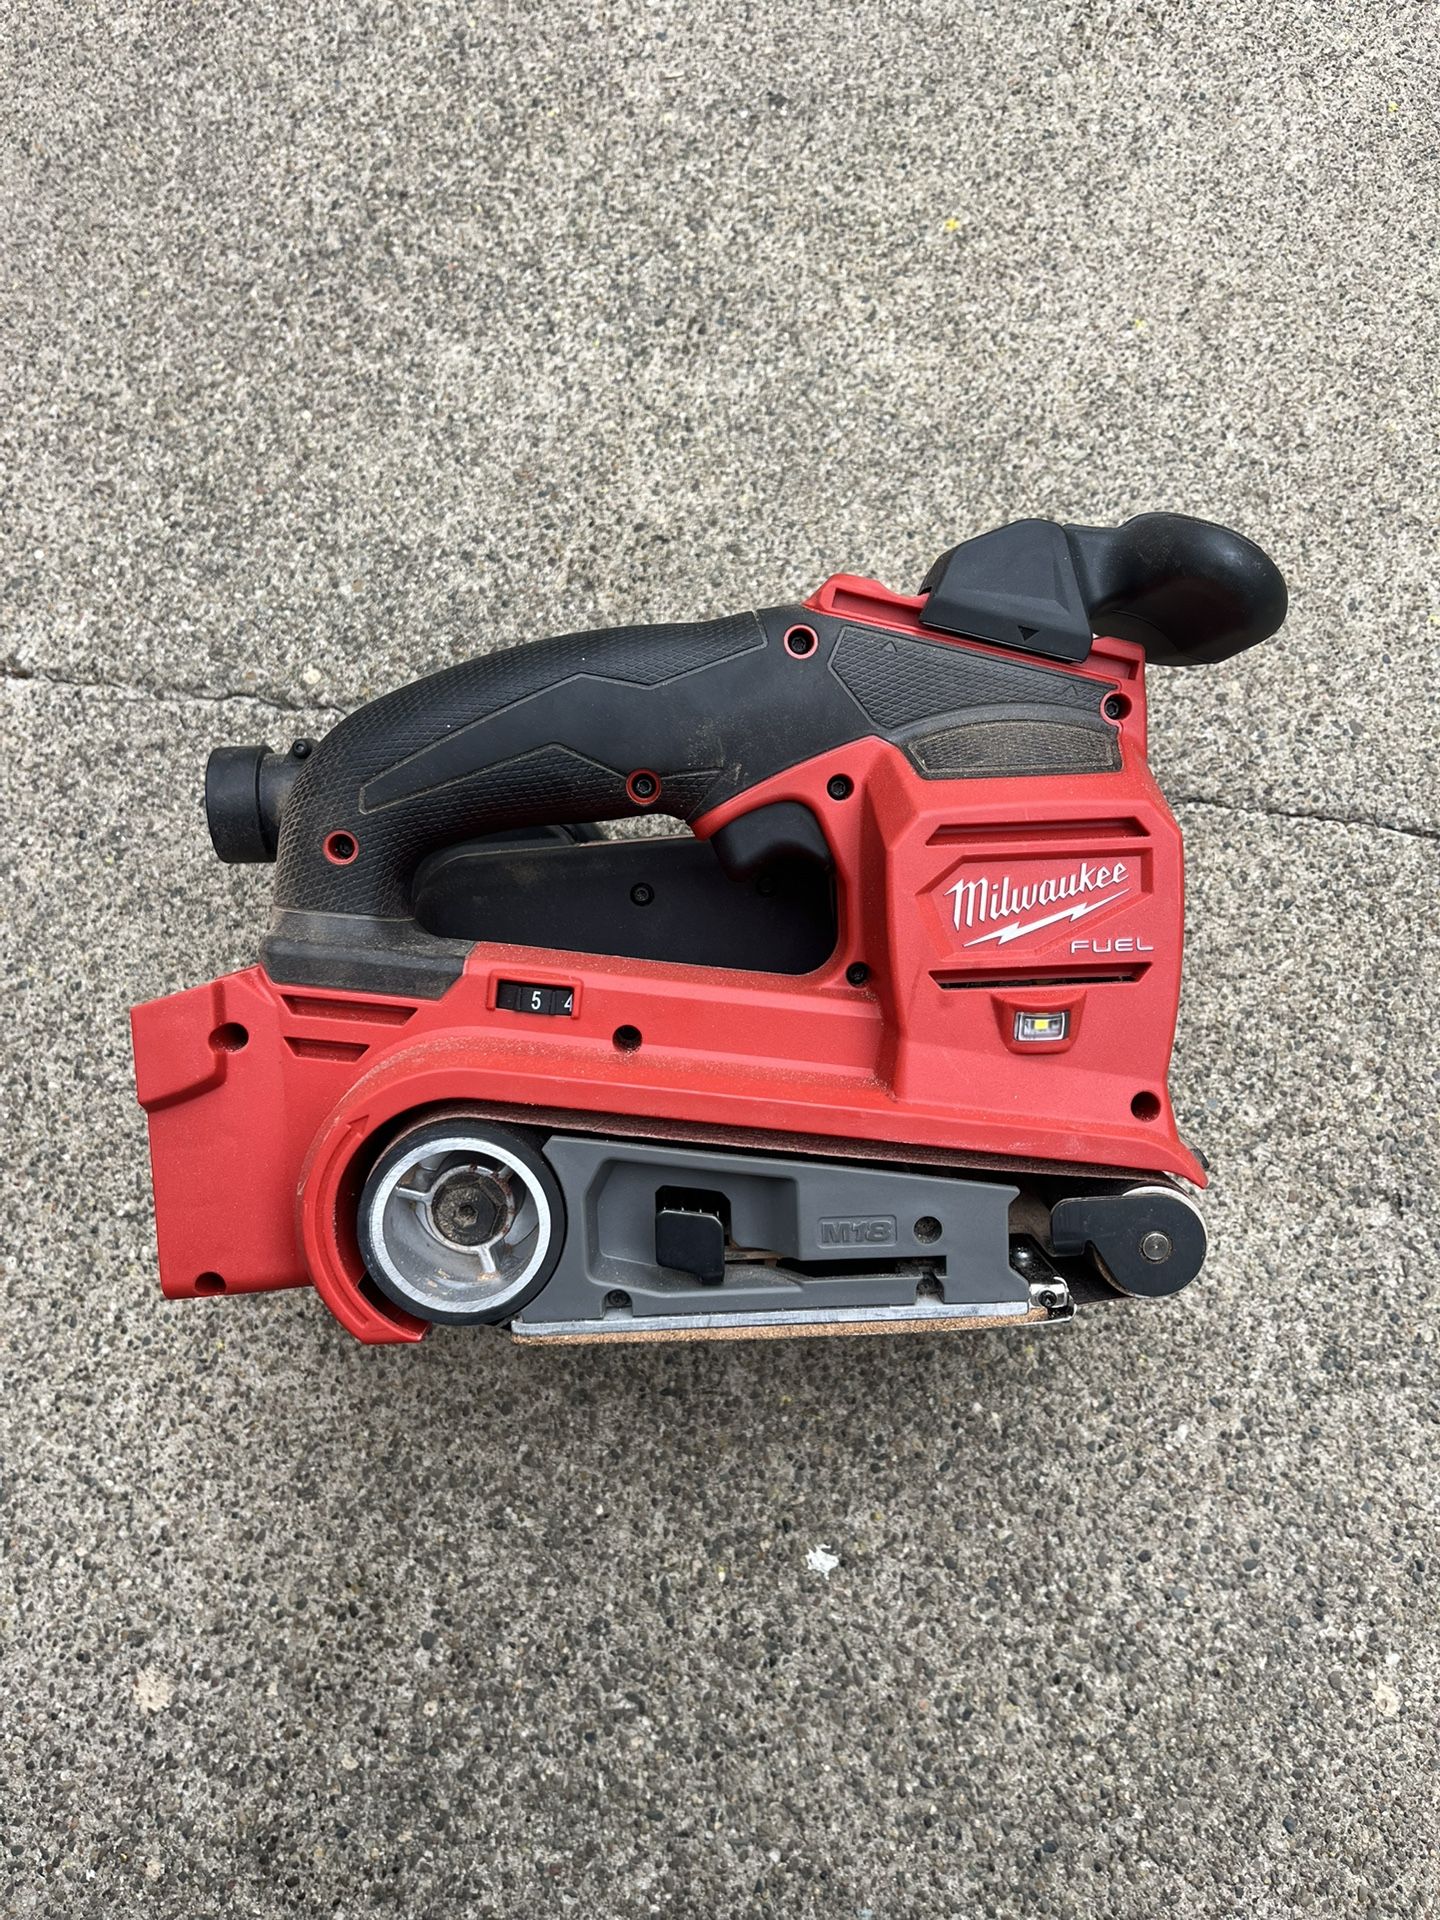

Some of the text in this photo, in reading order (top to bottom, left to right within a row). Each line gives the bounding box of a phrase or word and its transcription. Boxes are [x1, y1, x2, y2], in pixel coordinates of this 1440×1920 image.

[944, 862, 1129, 931] Milwaukee
[1071, 937, 1154, 954] FUEL
[531, 991, 573, 1012] 5 4
[821, 1220, 892, 1243] M18
